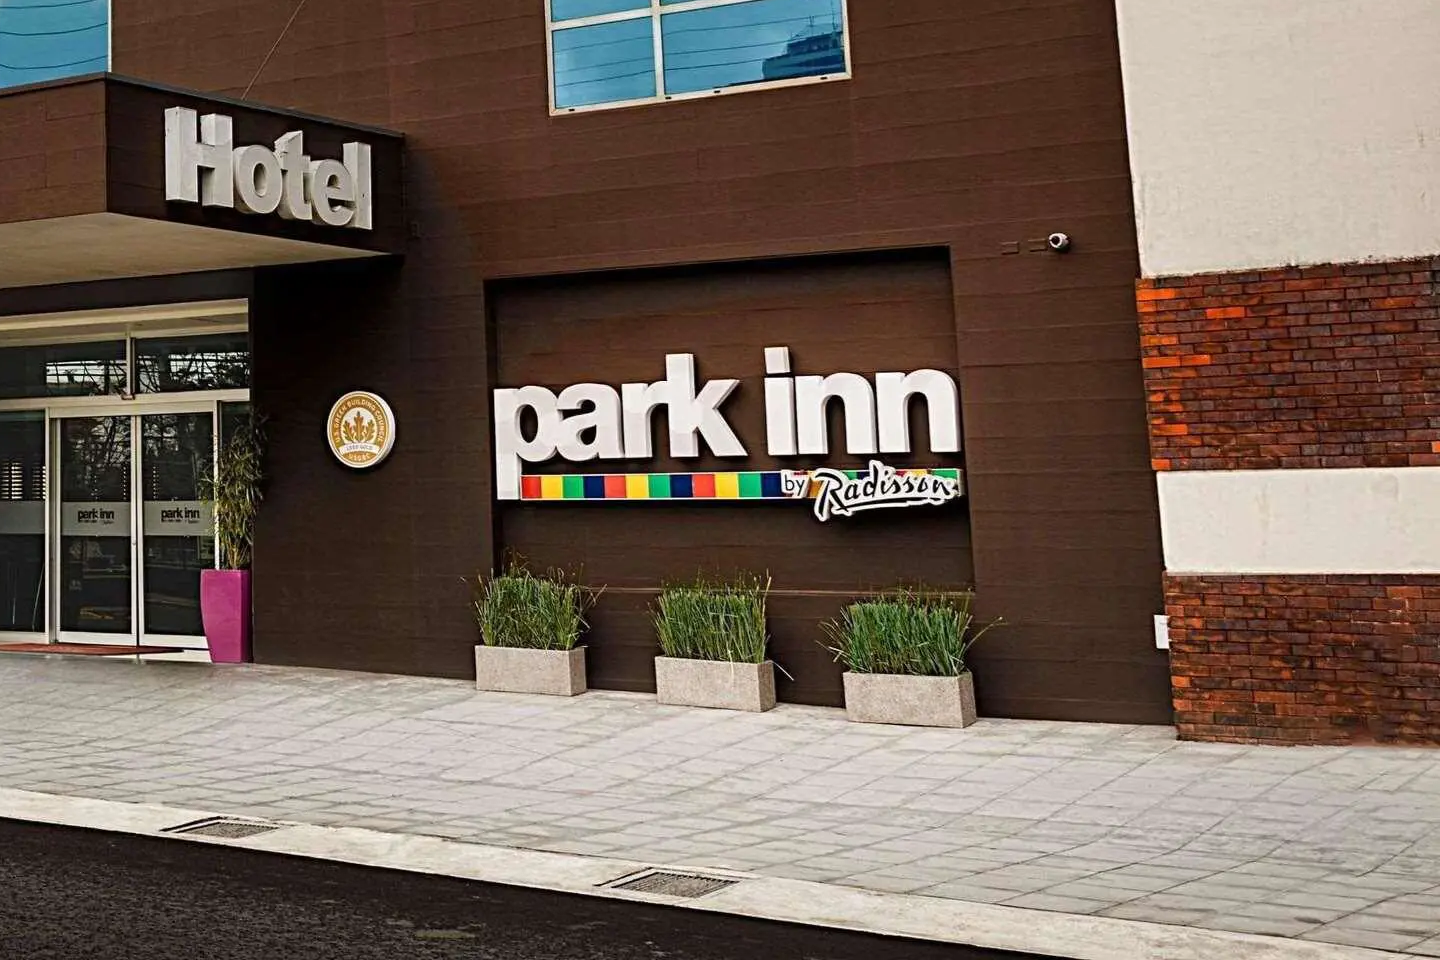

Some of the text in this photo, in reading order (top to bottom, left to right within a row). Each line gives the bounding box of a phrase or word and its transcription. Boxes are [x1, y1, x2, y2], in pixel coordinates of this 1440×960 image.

[165, 106, 372, 230] Hotel
[494, 346, 961, 500] park inn
[77, 508, 115, 523] park inn
[161, 507, 200, 522] park inn
[784, 462, 952, 520] by Radisson
